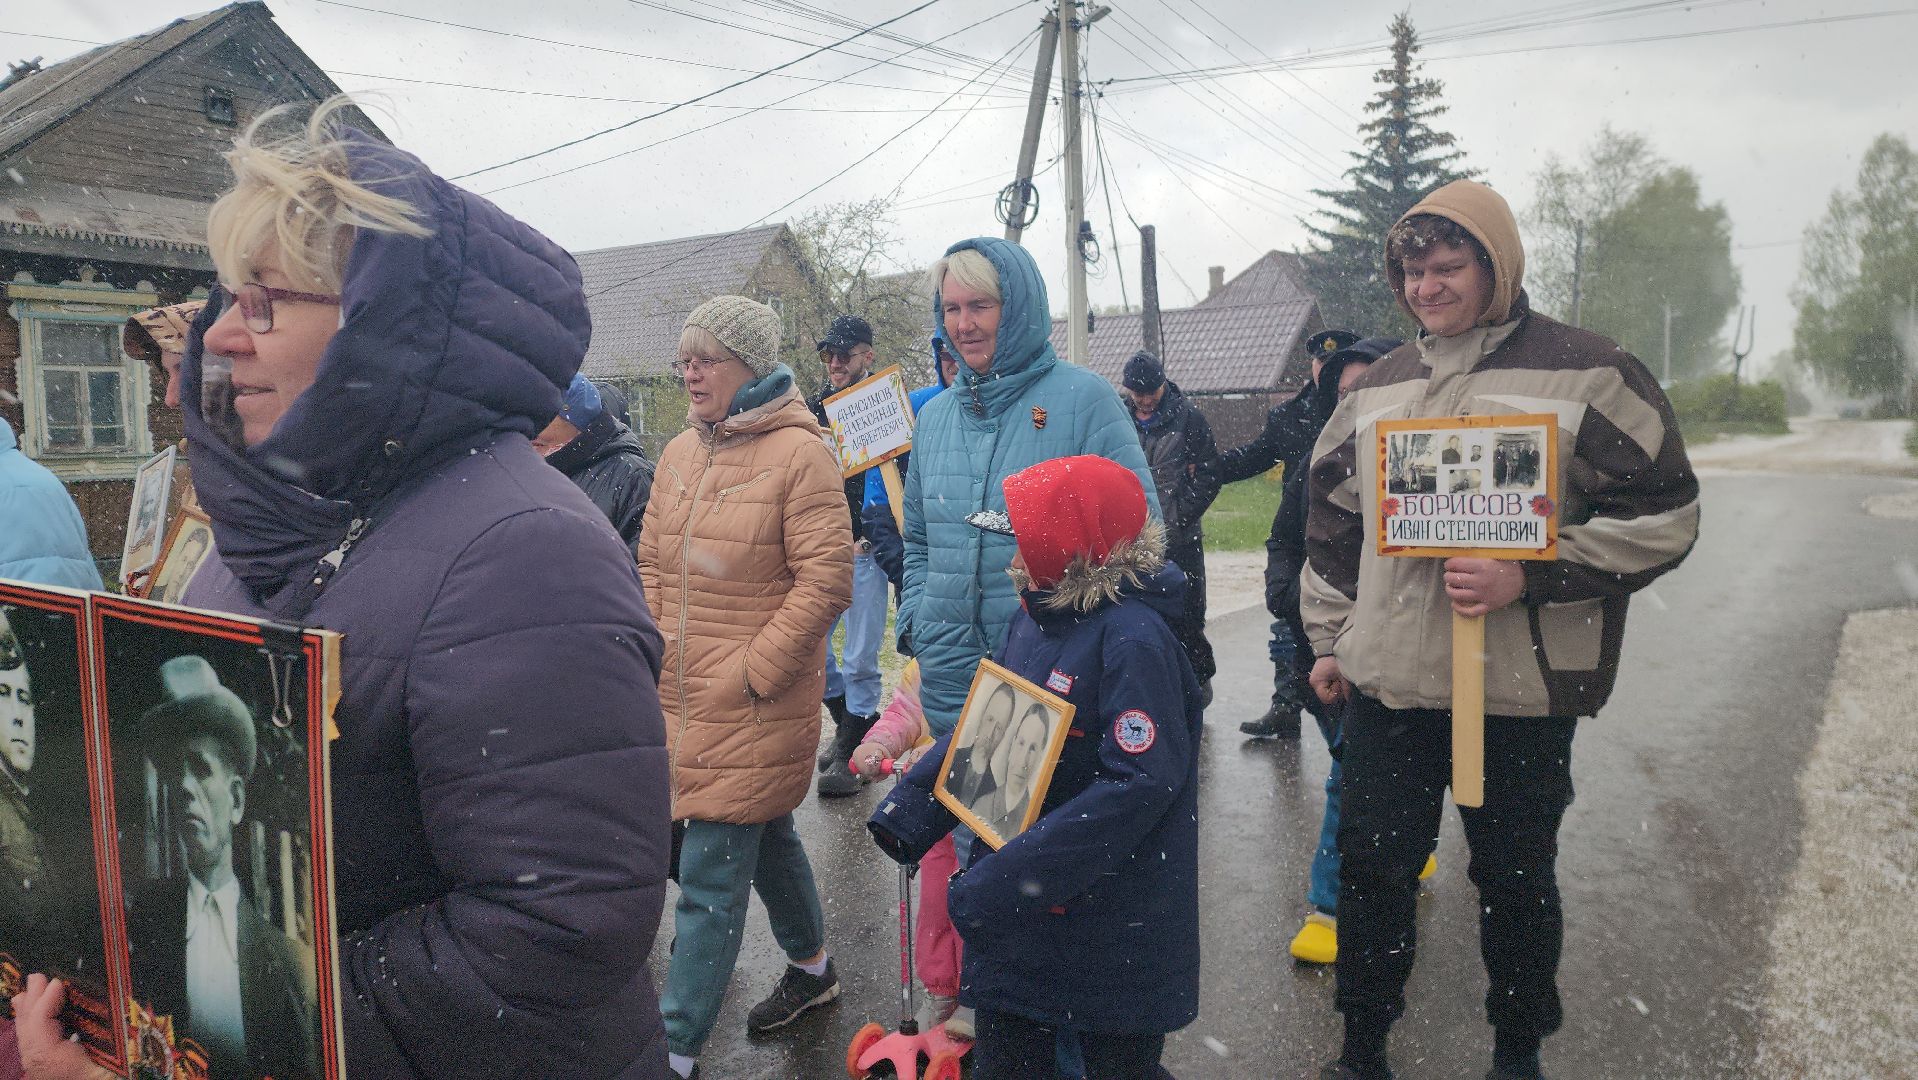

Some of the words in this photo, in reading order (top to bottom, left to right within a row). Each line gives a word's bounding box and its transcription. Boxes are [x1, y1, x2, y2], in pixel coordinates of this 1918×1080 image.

[836, 386, 893, 424] АНИСИМОВ
[843, 401, 899, 437] АЛЕКСАНДР
[1403, 493, 1523, 516] БОРИСОВ
[1391, 519, 1431, 541] ИВАН
[1435, 520, 1539, 543] СТЕПАНОВИЧ
